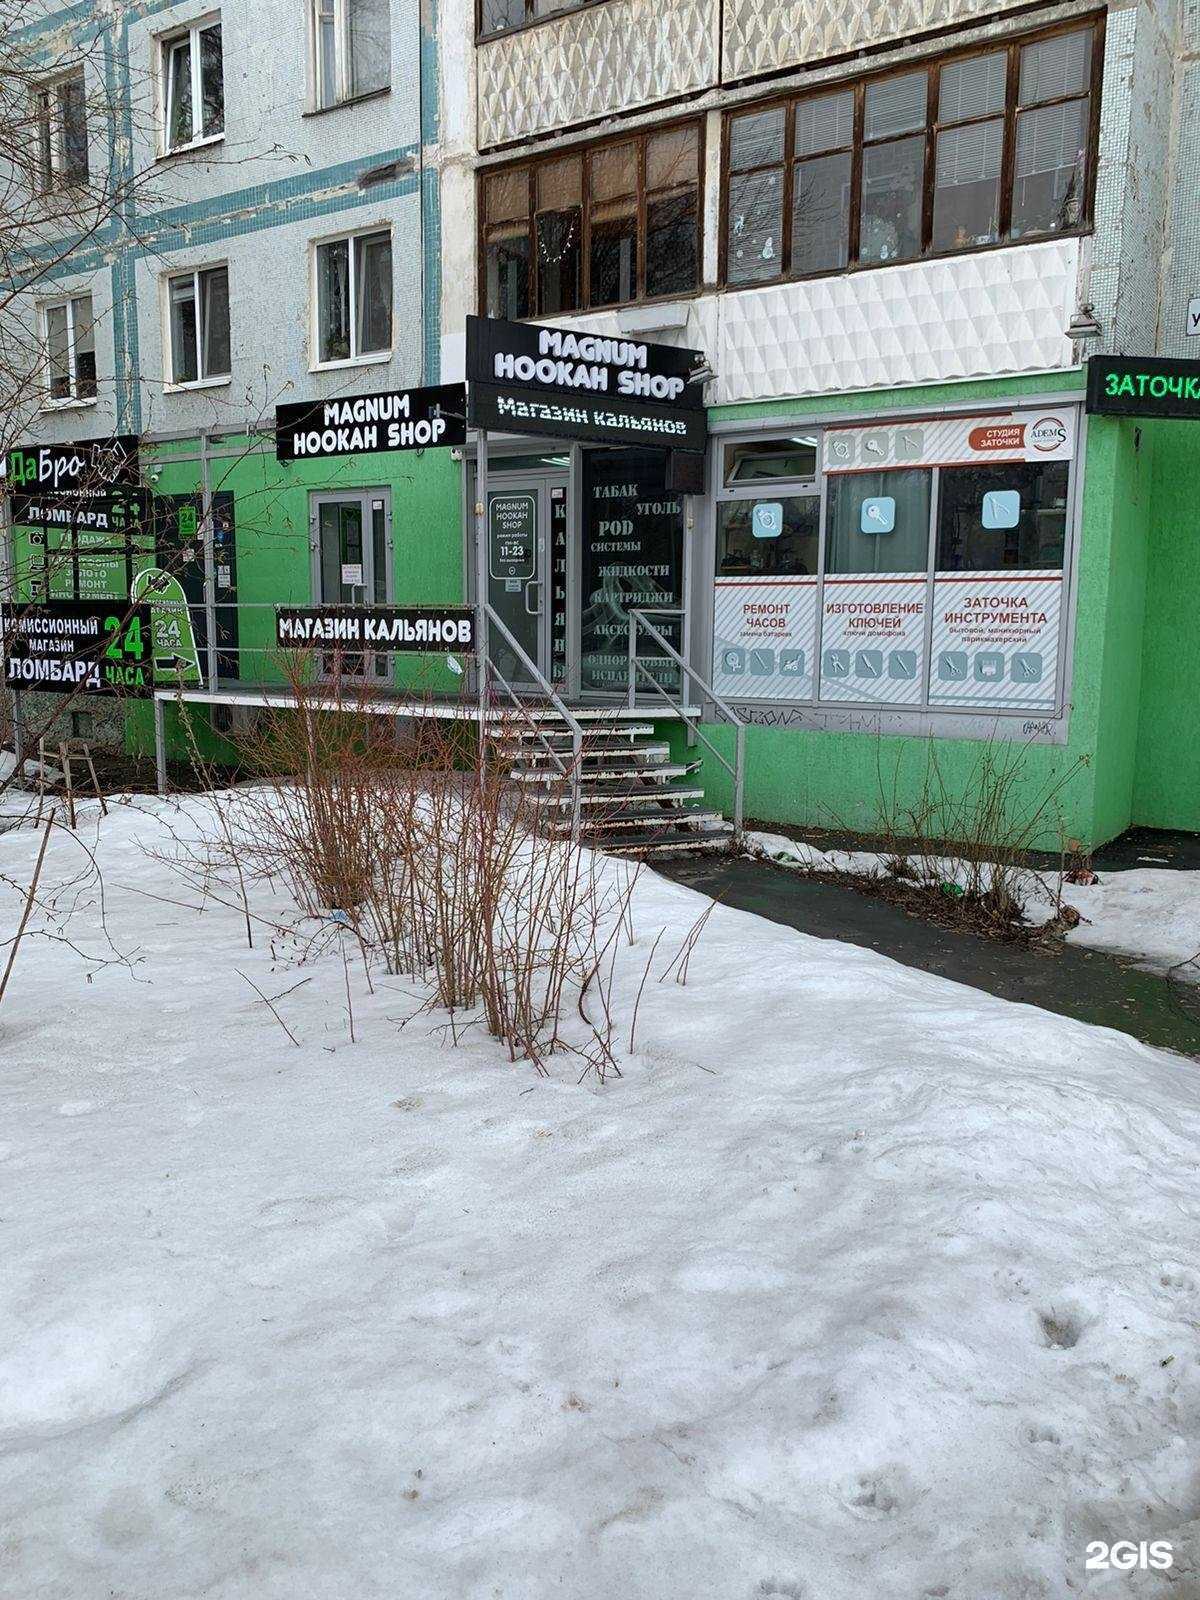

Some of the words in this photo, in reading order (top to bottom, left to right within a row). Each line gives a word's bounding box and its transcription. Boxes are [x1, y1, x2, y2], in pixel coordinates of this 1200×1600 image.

[539, 329, 648, 369] MAGNUM
[494, 352, 609, 391] HOOKAH
[617, 370, 685, 400] SHOP
[1105, 373, 1200, 399] ЗАТОЧК
[324, 394, 410, 426] MAGNUM
[497, 396, 589, 424] Магазин
[594, 411, 687, 435] кальянов
[293, 425, 378, 455] HOOKAH
[388, 418, 446, 447] SHOP
[986, 428, 1020, 438] СТУДИЯ
[980, 438, 1020, 447] ЗАТОЧКИ
[10, 449, 86, 487] ДаБро
[593, 484, 638, 498] ТАБАК
[496, 502, 529, 511] MAGNUM
[637, 502, 681, 515] УГОЛЬ
[496, 512, 528, 520] HOOKAH
[502, 521, 522, 529] SHOP
[599, 520, 634, 536] POD
[501, 546, 524, 556] 11-23
[591, 541, 641, 552] СИСТЕМЫ
[598, 565, 670, 577] ЖИДКОСТИ
[743, 604, 790, 614] РЕМОНТ
[826, 603, 923, 614] ИЗГОТОВЛЕНИЕ
[964, 597, 1028, 608] ЗАТОЧКА
[747, 618, 786, 628] ЧАСОВ
[849, 616, 901, 628] КЛЮЧЕЙ
[944, 612, 1048, 623] ИНСТРУМЕНТА
[155, 620, 181, 638] 24
[279, 618, 360, 640] МАГАЗИН
[364, 618, 472, 643] КАЛЬЯНОВ
[104, 616, 144, 660] 24
[156, 638, 182, 647] ЧАСА
[29, 639, 74, 652] МАГАЗИН
[8, 657, 101, 688] ЛОМБАРД
[105, 666, 145, 685] ЧАСА
